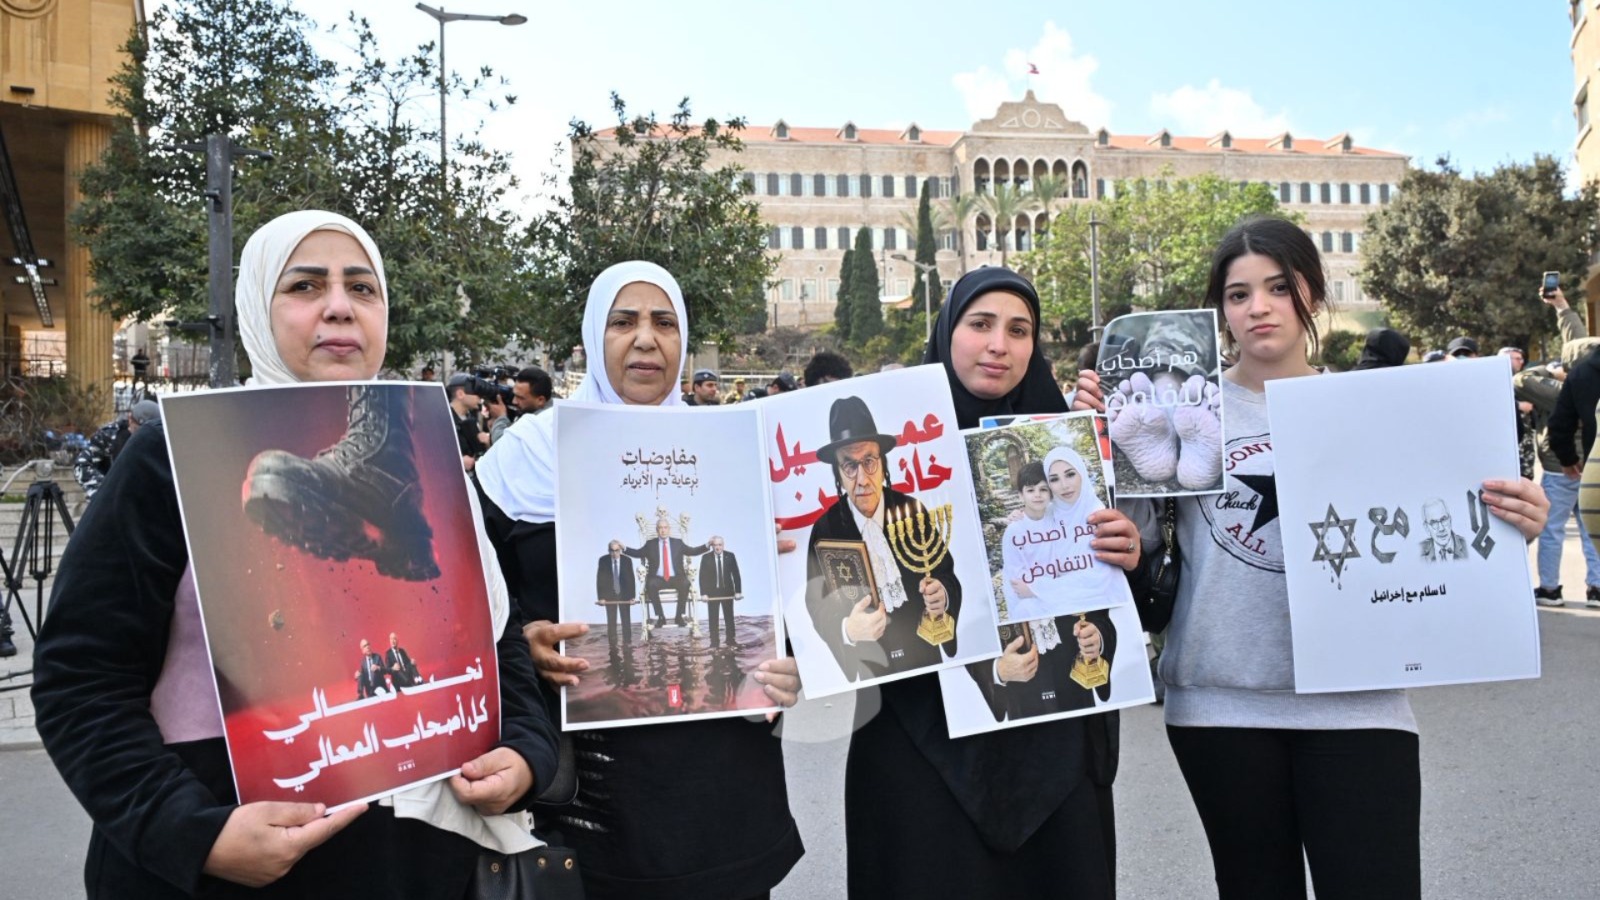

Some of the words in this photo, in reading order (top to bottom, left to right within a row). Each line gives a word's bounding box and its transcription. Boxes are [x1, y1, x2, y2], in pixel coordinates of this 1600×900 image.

[1101, 347, 1161, 375] أصحاب
[1168, 350, 1198, 373] هم
[622, 447, 698, 472] مفاوضات
[769, 413, 944, 483] عميل
[622, 471, 653, 489] الأبرياء
[671, 473, 699, 489] برعاية
[775, 447, 953, 531] خائن
[1215, 491, 1259, 511] Chuck
[1012, 520, 1067, 551] أصحاب
[1225, 523, 1267, 556] ALL
[1021, 553, 1094, 584] التفاوض
[1405, 590, 1418, 603] مع
[1419, 584, 1439, 602] سلام
[400, 657, 483, 696] تحت
[262, 677, 397, 745] نعالي
[382, 694, 466, 750] أصحاب
[467, 694, 488, 733] كل
[272, 721, 380, 793] المعالي
